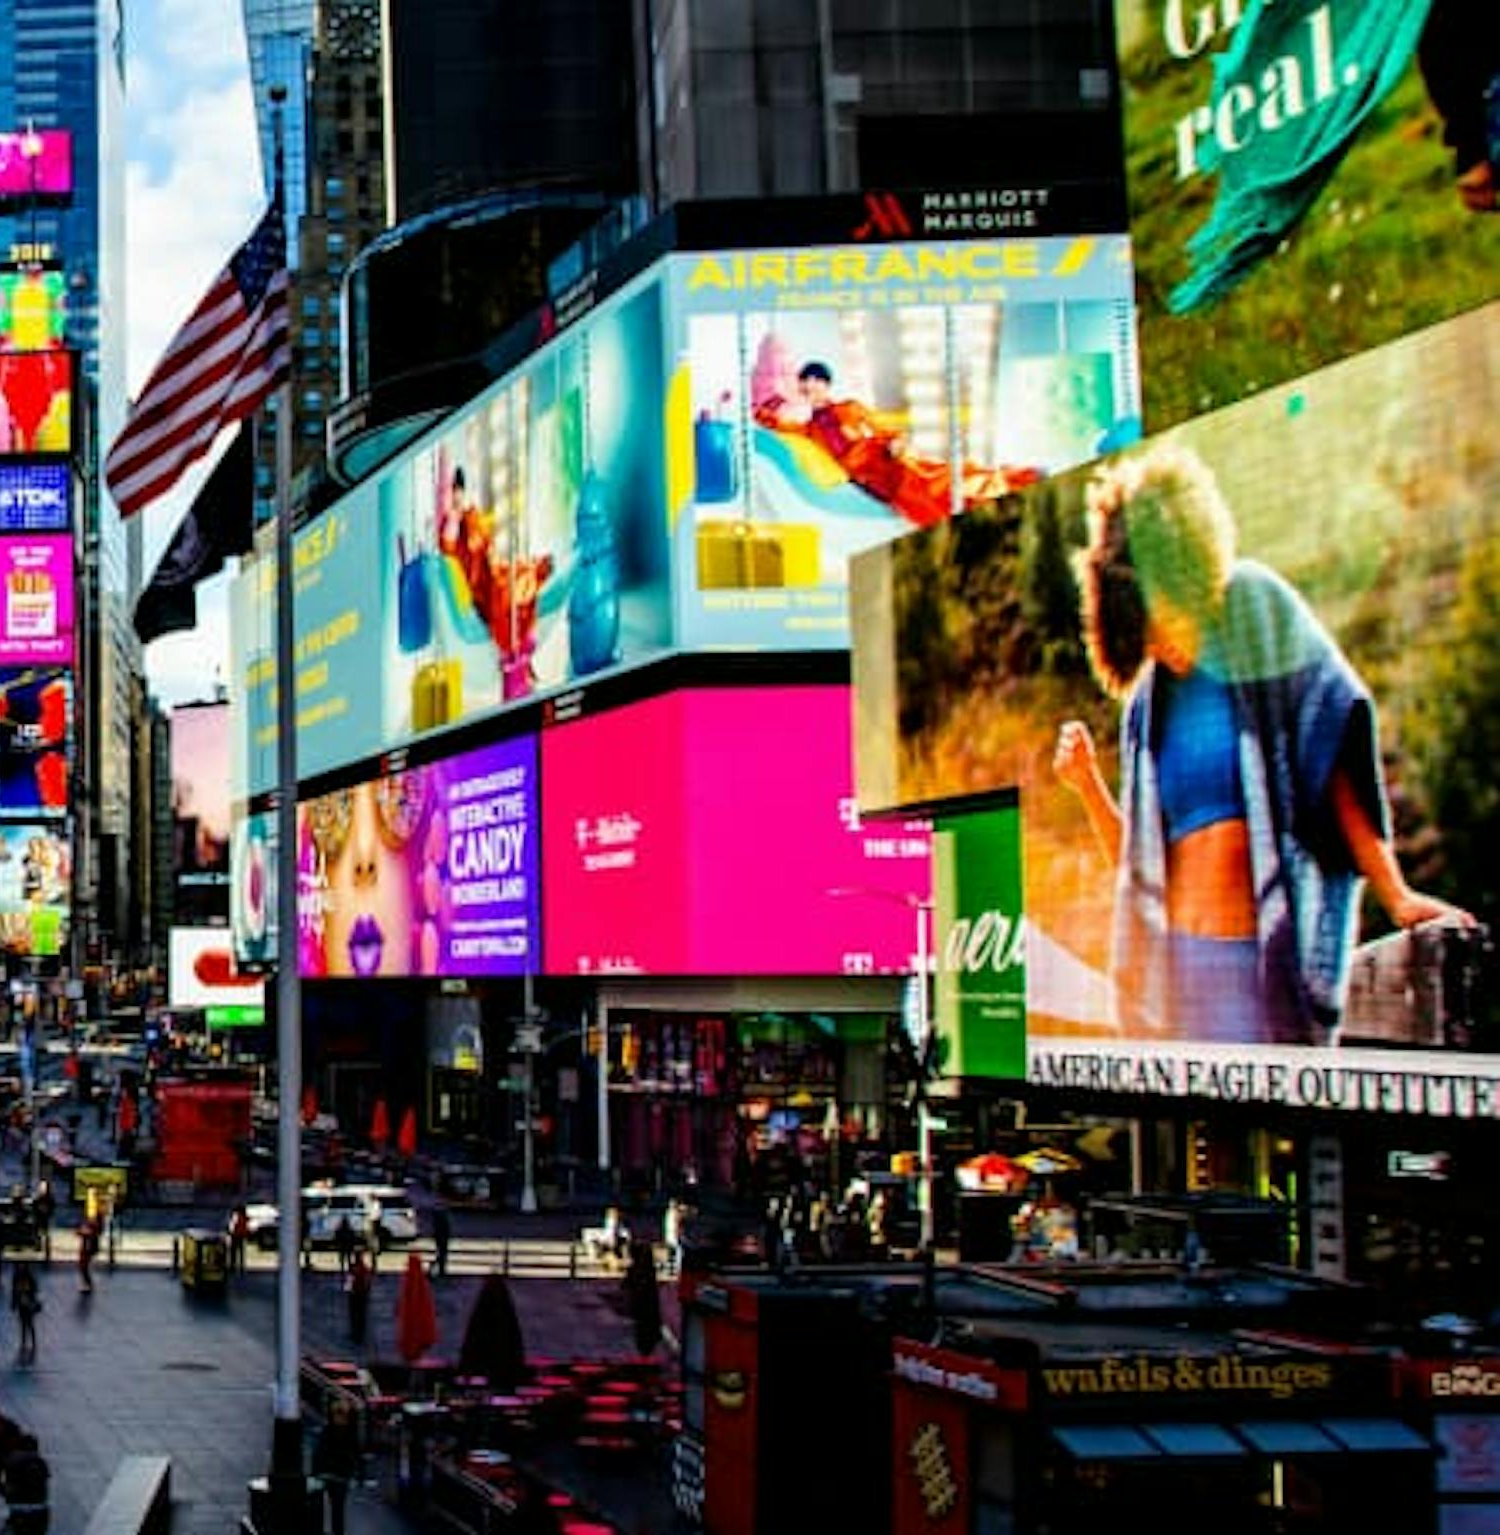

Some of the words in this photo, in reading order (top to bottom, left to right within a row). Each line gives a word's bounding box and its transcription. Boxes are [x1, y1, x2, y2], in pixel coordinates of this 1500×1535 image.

[1174, 2, 1360, 184] real.
[923, 188, 1049, 211] MARRIOTT
[923, 209, 1038, 232] MARQUIS
[450, 820, 528, 880] CANDY
[1029, 1052, 1175, 1097] AMERICAN
[1186, 1060, 1290, 1105] EAGLE
